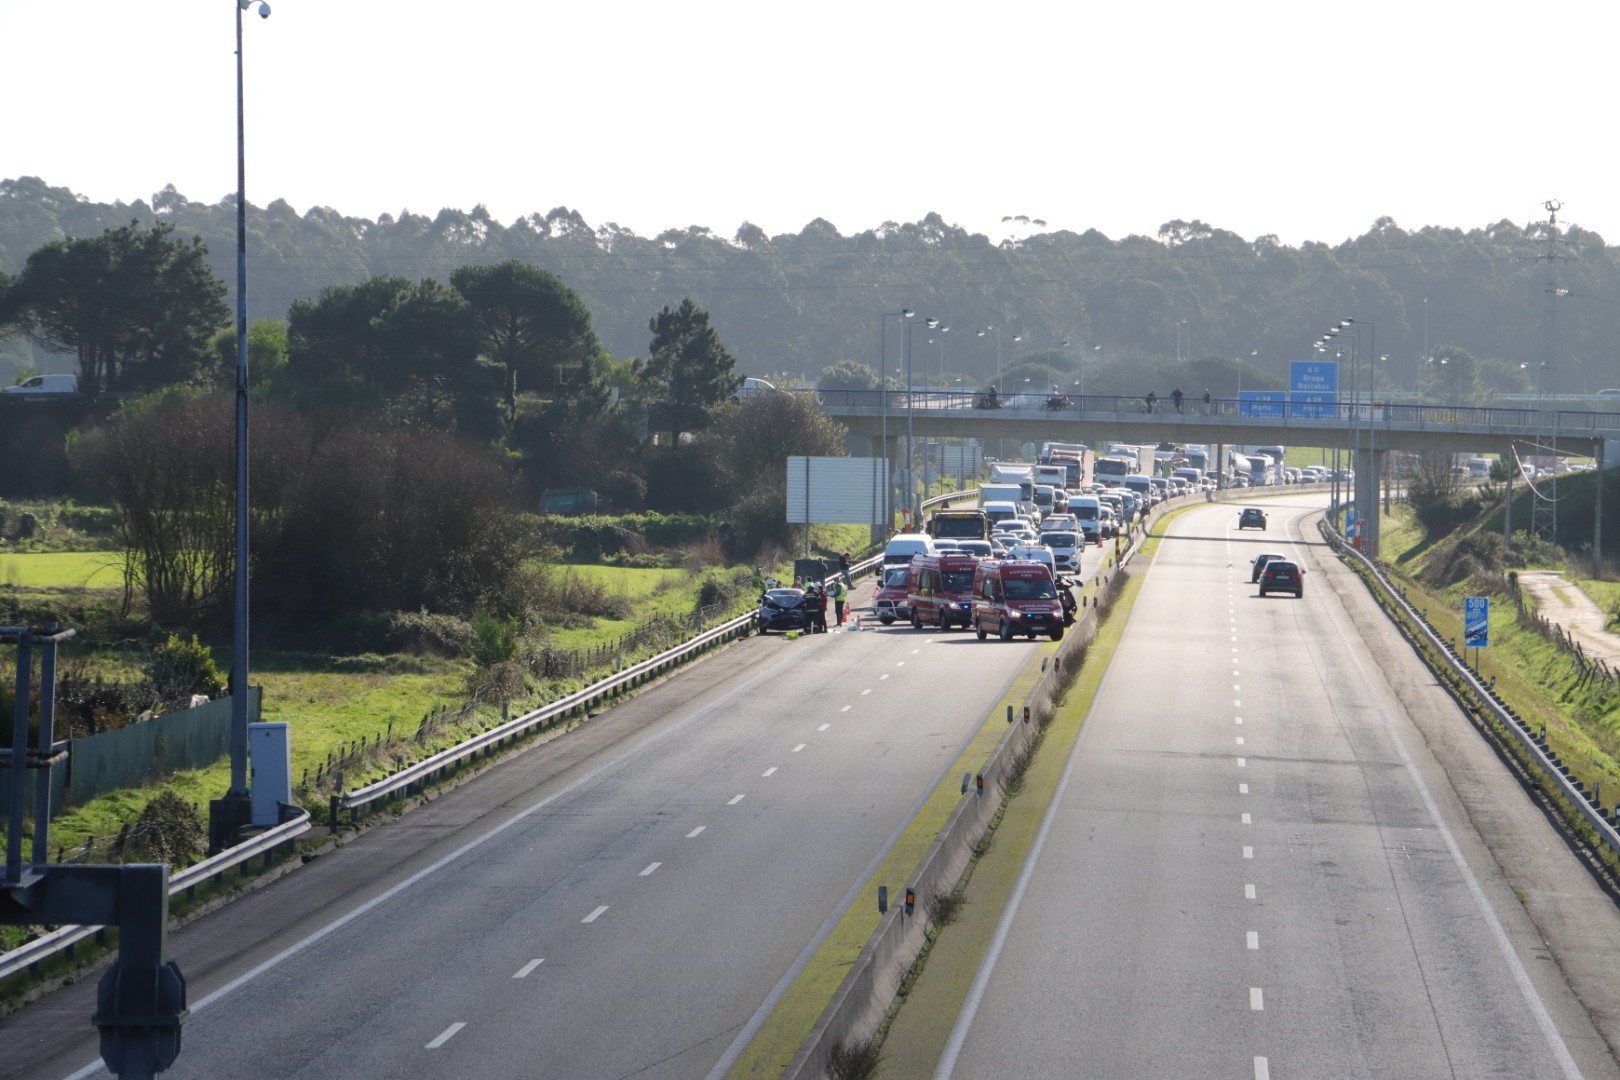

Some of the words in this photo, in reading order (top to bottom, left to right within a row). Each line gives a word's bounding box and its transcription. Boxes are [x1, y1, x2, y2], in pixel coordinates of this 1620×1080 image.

[1303, 374, 1325, 382] Braga
[1298, 382, 1330, 391] Barcelos
[1469, 599, 1485, 608] 500
